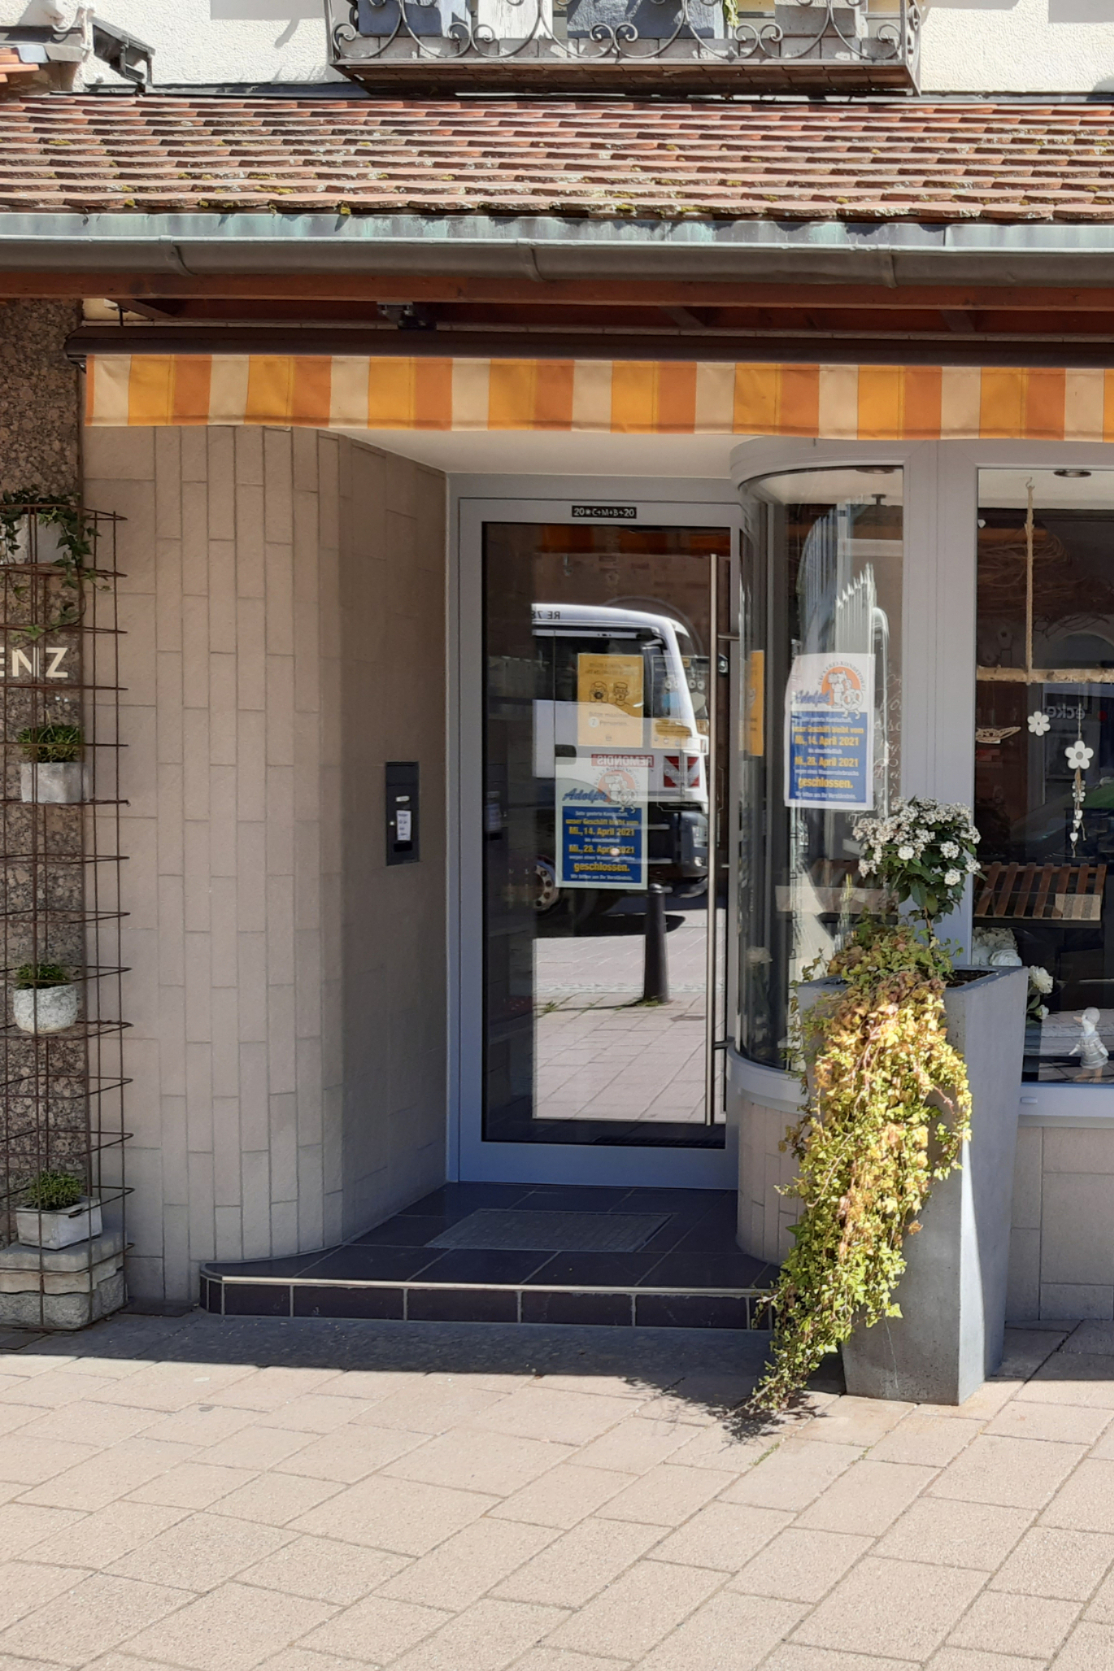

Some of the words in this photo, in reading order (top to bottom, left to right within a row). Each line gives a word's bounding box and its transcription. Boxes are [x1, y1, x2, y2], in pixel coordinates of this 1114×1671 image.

[0, 646, 69, 678] NZ
[819, 736, 837, 747] April
[839, 737, 860, 746] 2021
[819, 757, 837, 767] April
[839, 758, 859, 767] 2021
[798, 777, 855, 789] geschlossen.
[584, 827, 595, 835] 14.
[597, 827, 615, 837] April
[616, 828, 635, 836] 2021
[573, 861, 630, 872] geschlossen.
